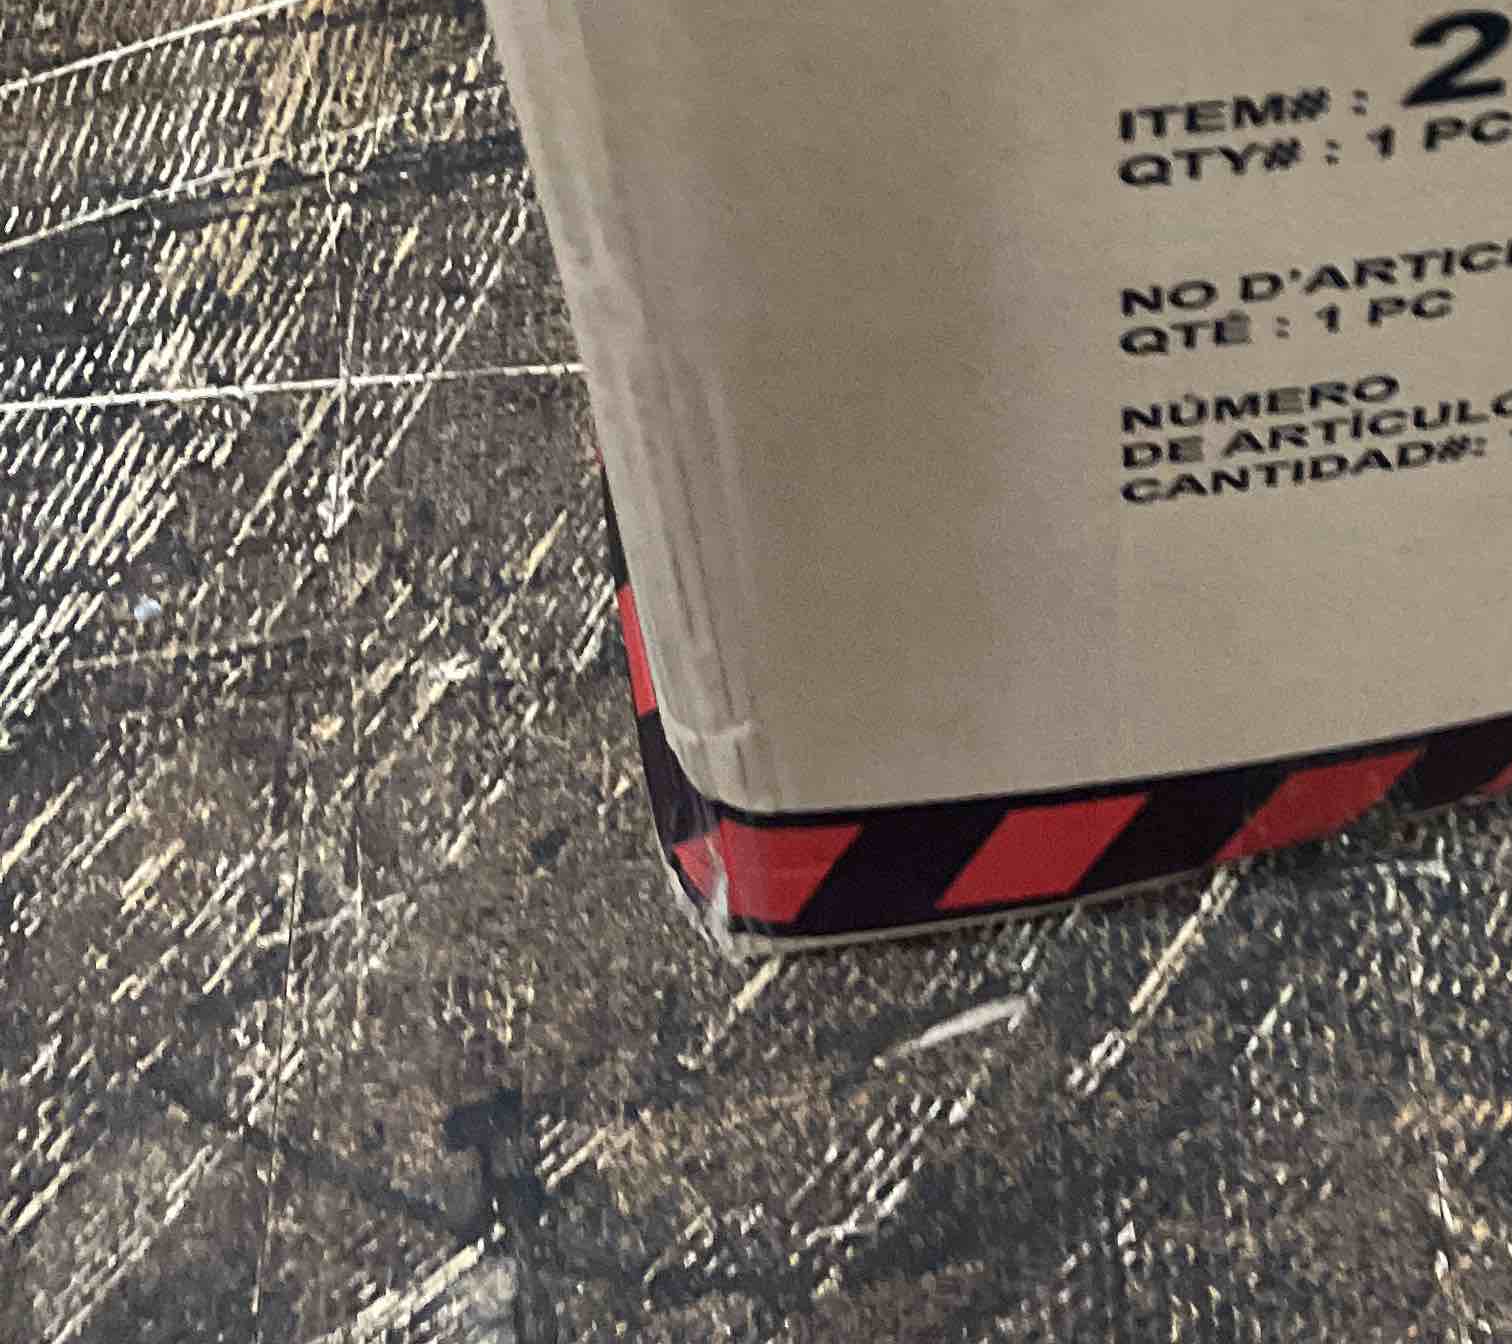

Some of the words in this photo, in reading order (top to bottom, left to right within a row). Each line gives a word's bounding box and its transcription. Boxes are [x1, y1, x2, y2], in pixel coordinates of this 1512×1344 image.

[1119, 87, 1330, 143] ITEM#
[1119, 137, 1301, 186] QTY#
[1366, 125, 1395, 158] 1
[1120, 280, 1217, 317] NO
[1316, 303, 1341, 334] 1
[1367, 289, 1453, 327] PC
[1121, 435, 1204, 471] DE
[1121, 434, 1488, 504] CANTIDAD#:
